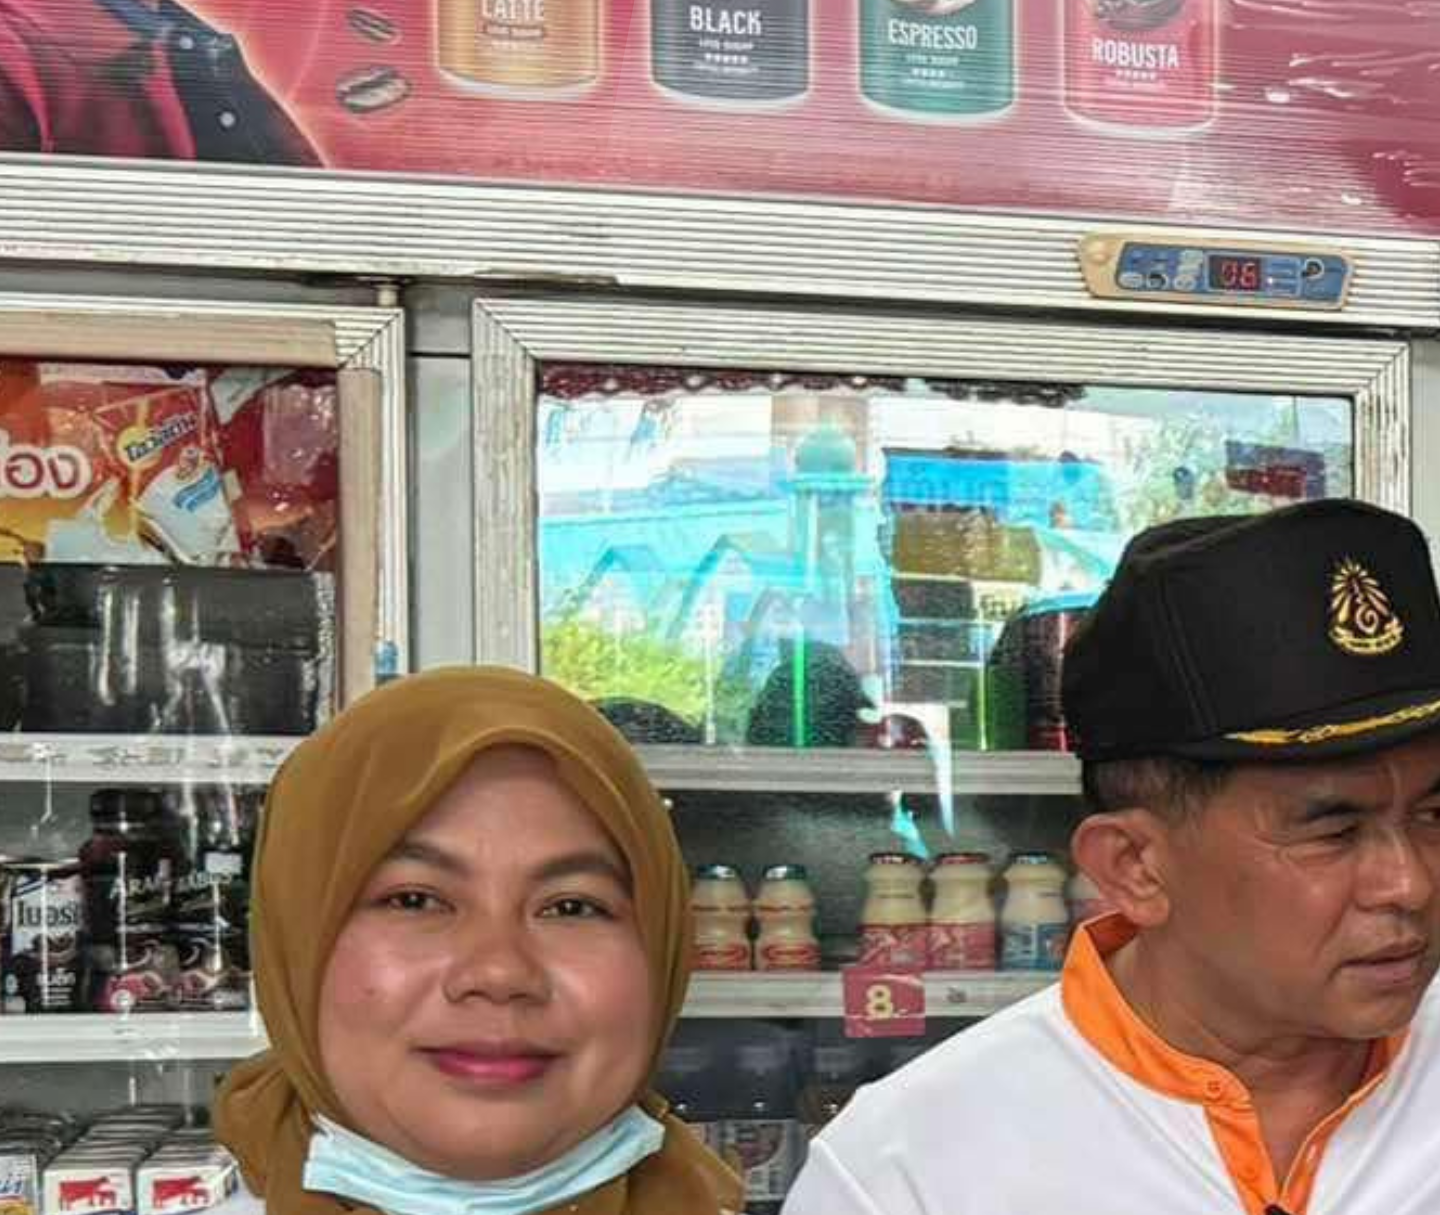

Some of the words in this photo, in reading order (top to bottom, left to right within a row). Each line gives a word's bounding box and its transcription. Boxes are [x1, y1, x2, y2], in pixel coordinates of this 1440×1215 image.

[481, 0, 546, 21] LATTE
[690, 6, 761, 35] BLACK
[887, 19, 978, 50] ESPRESSO
[1091, 37, 1180, 69] ROBUSTA
